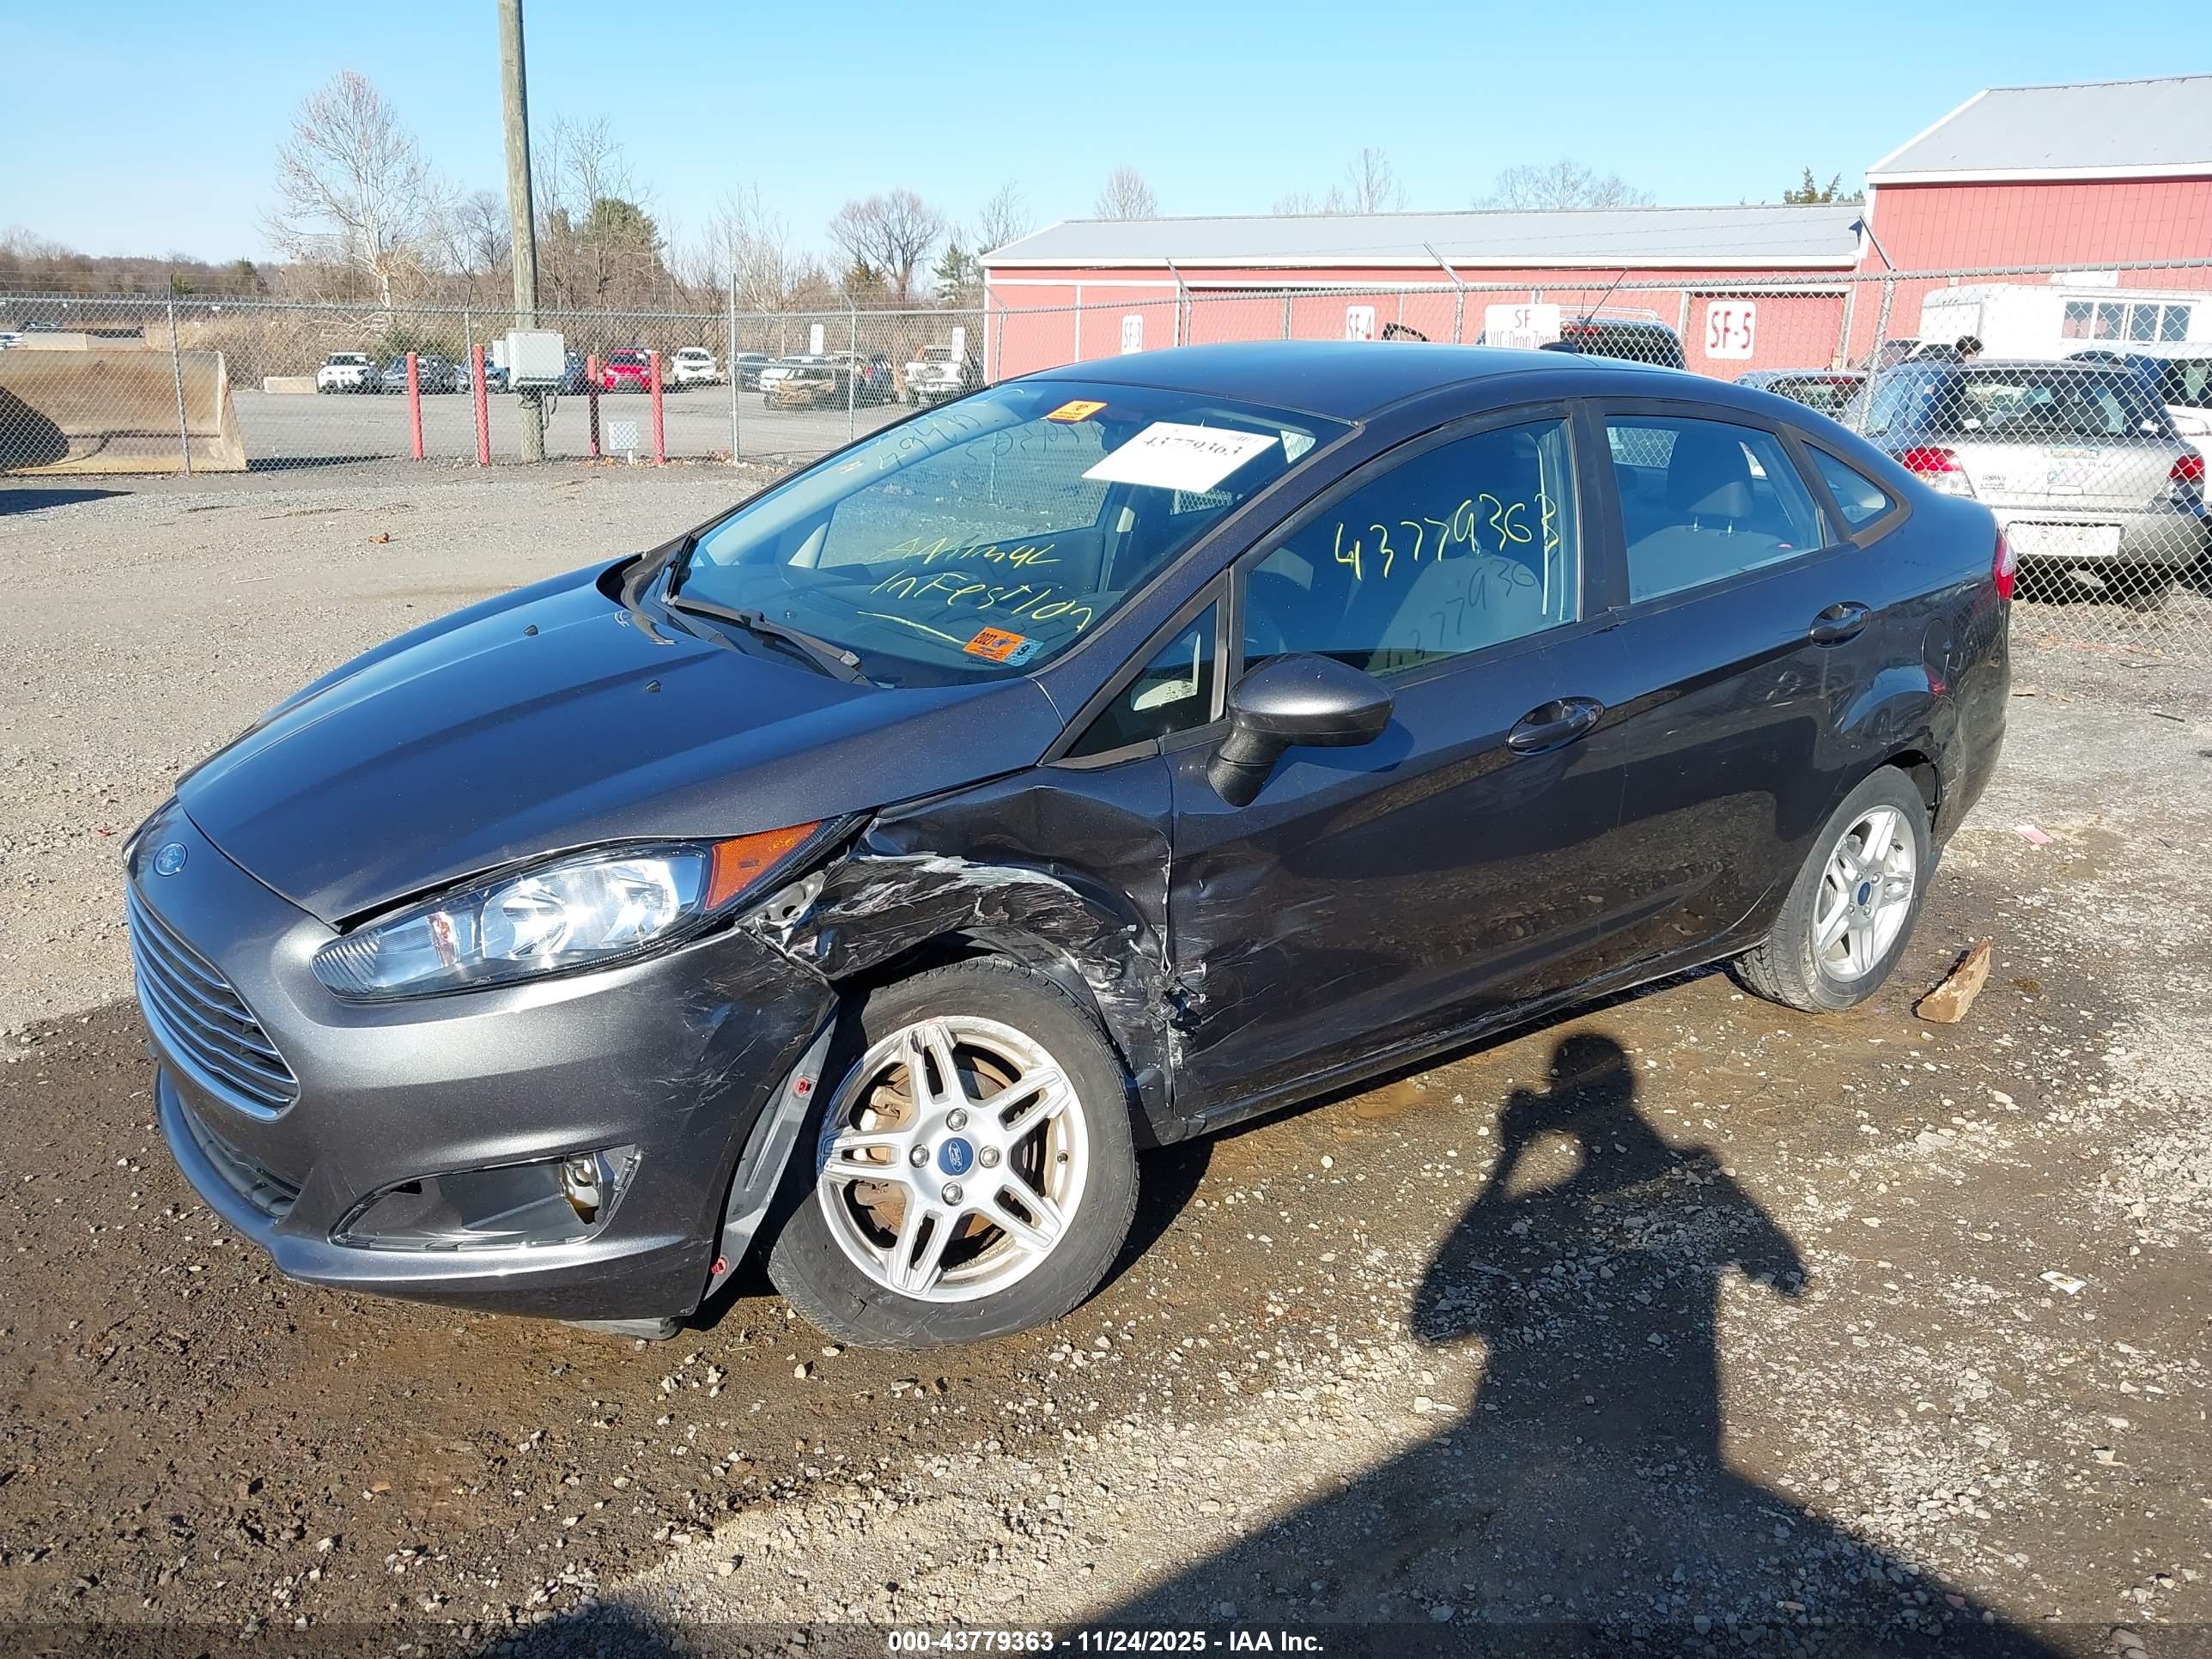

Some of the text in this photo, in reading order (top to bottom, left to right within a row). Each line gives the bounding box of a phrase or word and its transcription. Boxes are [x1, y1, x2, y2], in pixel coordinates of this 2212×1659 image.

[1515, 309, 1531, 328] SF
[1711, 310, 1752, 349] SF-5
[1334, 493, 1559, 581] 43779363
[973, 631, 998, 646] 2027
[1017, 644, 1030, 656] 9
